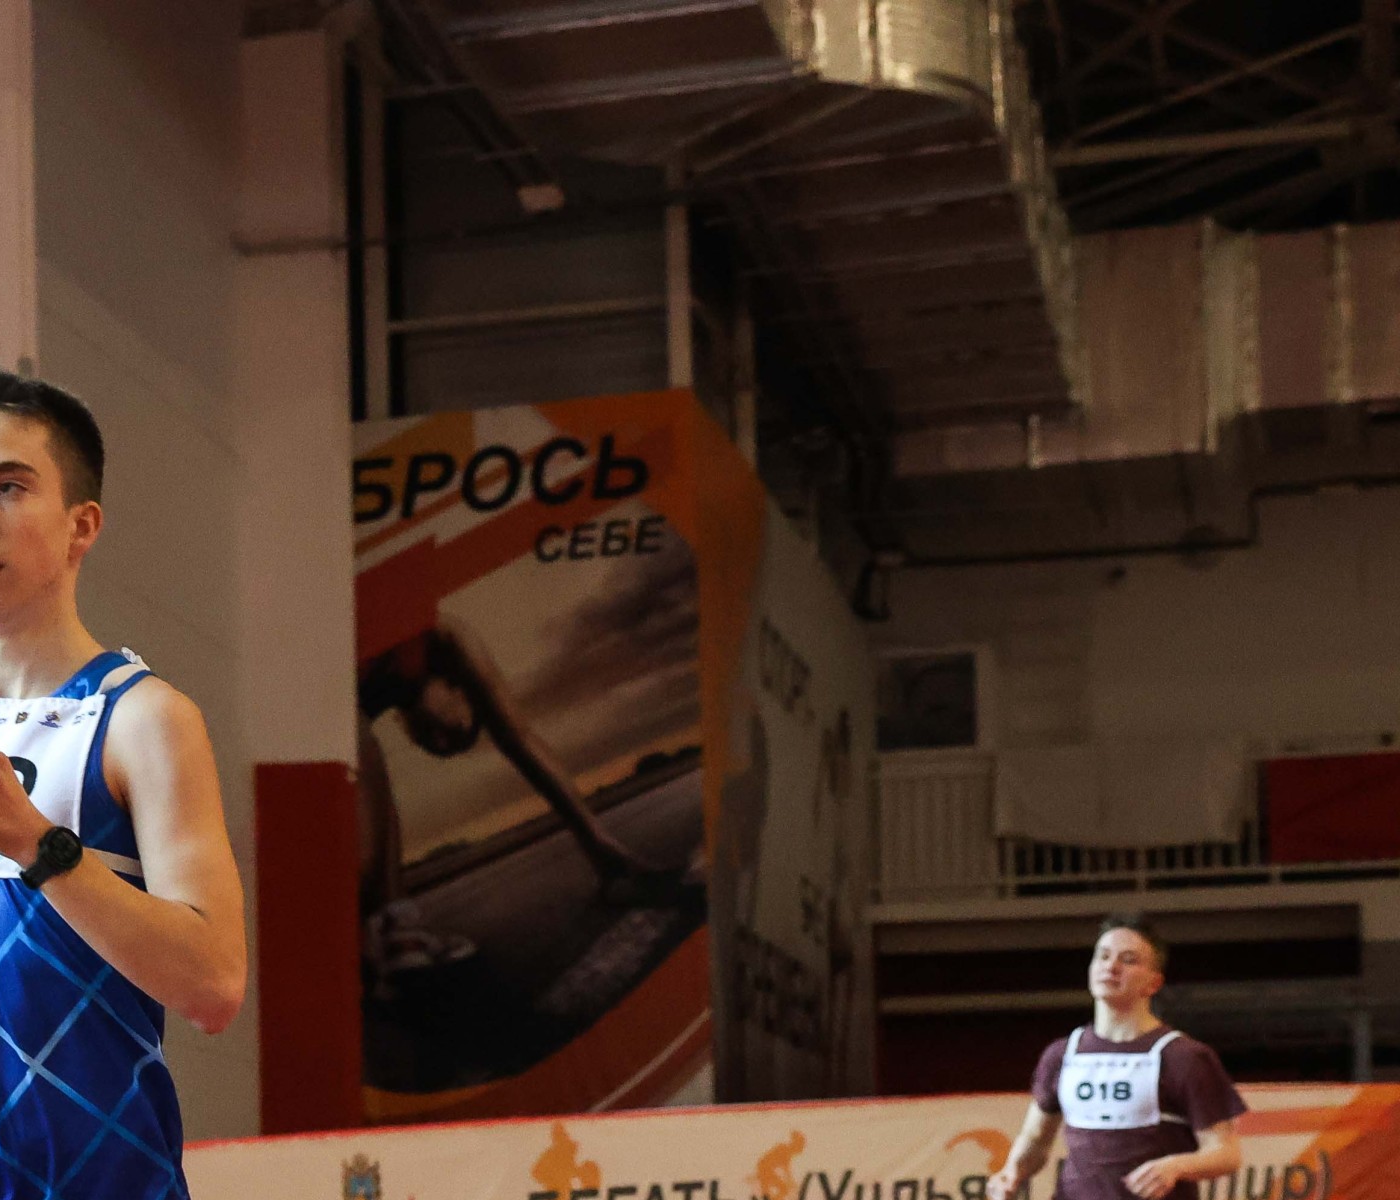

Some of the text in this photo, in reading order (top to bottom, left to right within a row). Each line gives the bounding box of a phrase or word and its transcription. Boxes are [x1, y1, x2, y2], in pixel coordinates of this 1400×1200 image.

[353, 434, 648, 523] БРОСЬ
[535, 514, 667, 563] СЕБЕ
[1077, 1082, 1131, 1100] 018
